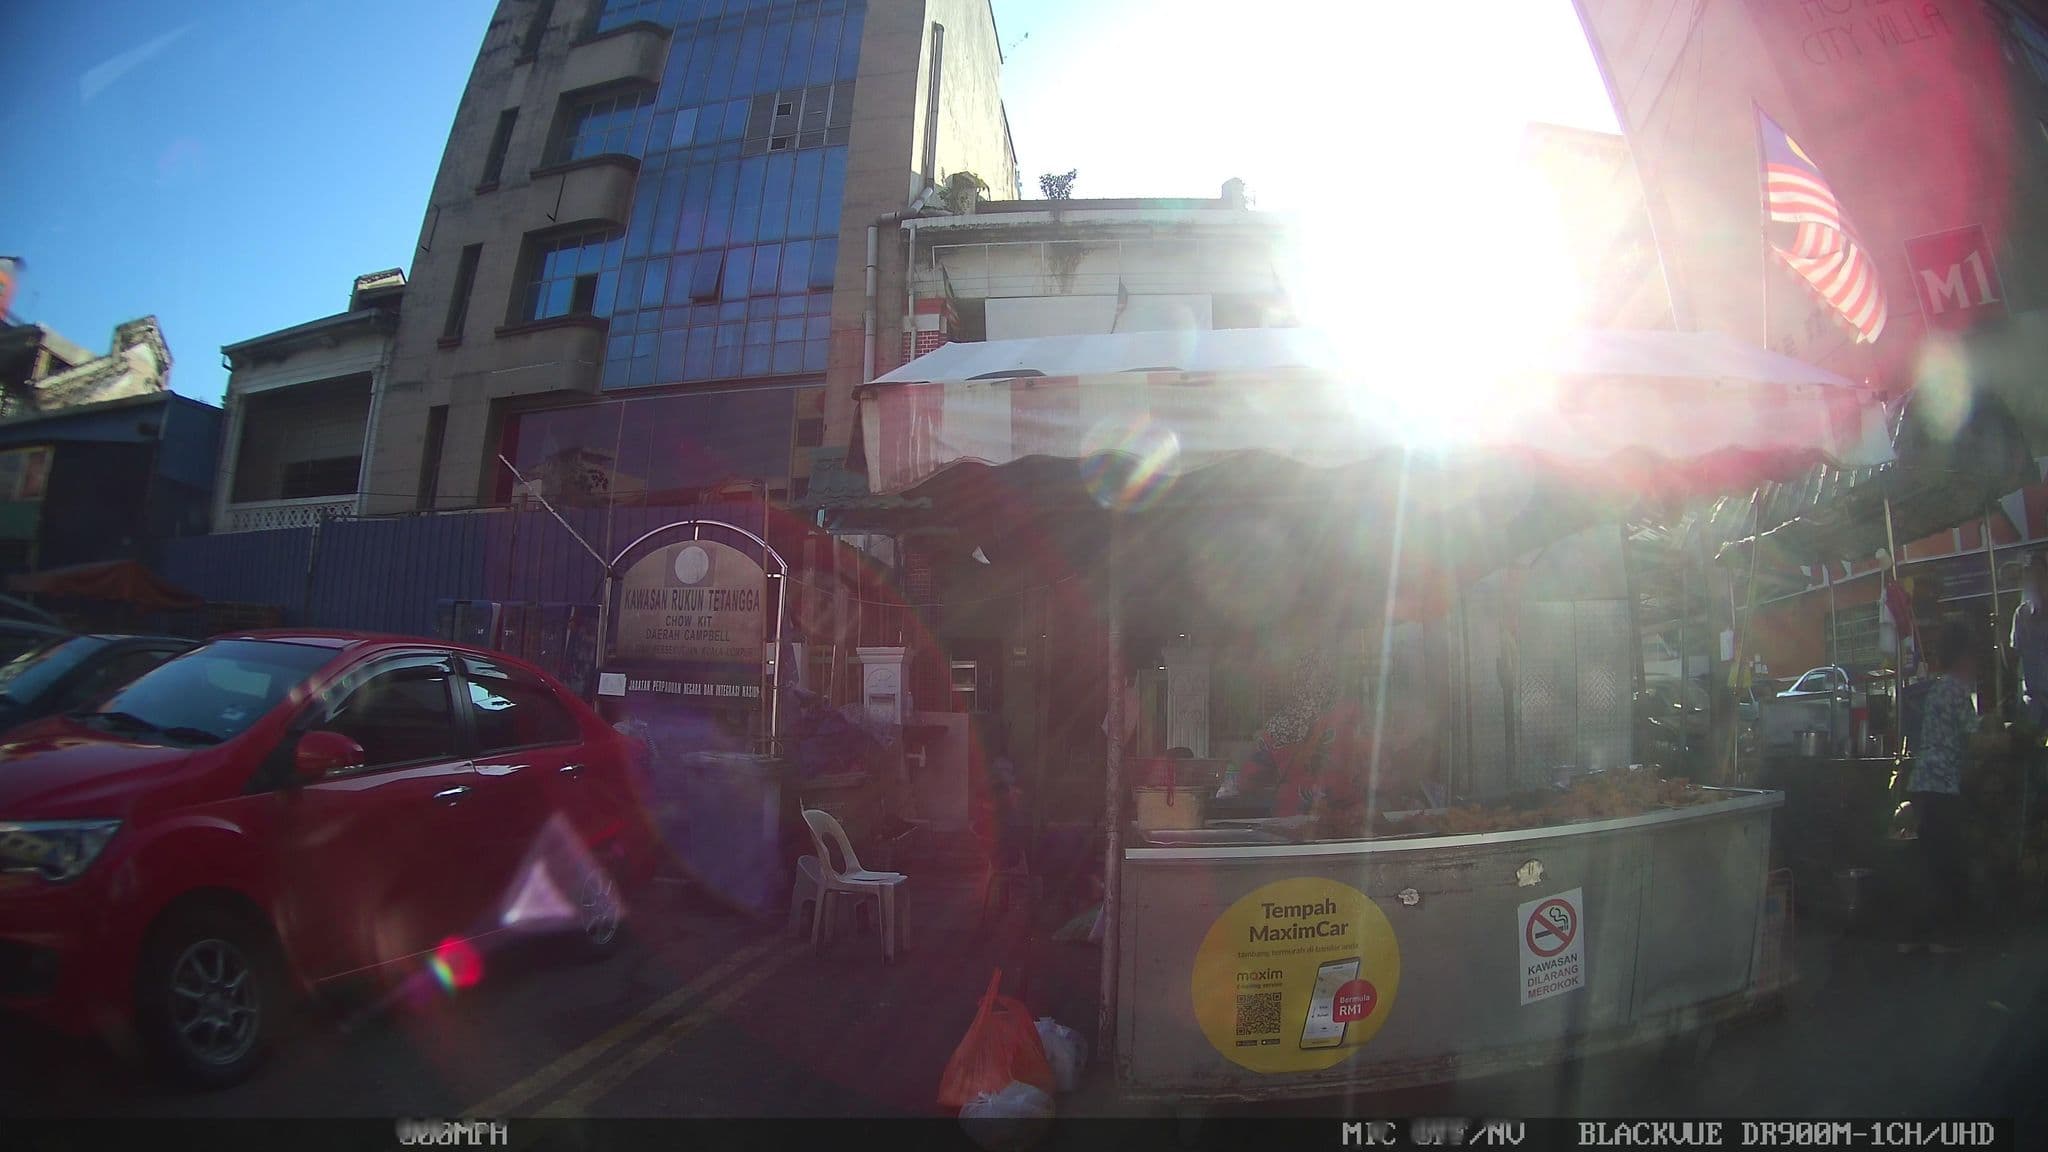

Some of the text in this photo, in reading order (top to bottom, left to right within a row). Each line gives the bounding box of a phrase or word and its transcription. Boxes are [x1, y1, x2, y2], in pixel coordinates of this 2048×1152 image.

[1802, 24, 1863, 65] CITY
[1865, 4, 1952, 46] VILLA
[1920, 250, 2000, 314] M1
[623, 588, 760, 612] KAWASAN RUKUN TETANGGA
[665, 615, 713, 628] CHOW KIT
[645, 629, 731, 642] DAERAH CAMPBELL
[703, 683, 714, 696] DAN
[1261, 898, 1337, 920] Tempah
[1249, 921, 1349, 943] MaximCar
[1236, 968, 1283, 982] maxim
[1527, 953, 1578, 975] KAWASAN
[1527, 964, 1579, 987] DILARANG
[1527, 976, 1579, 998] MEROKOK
[1339, 994, 1371, 1004] Bermula
[1339, 1006, 1362, 1017] RM1
